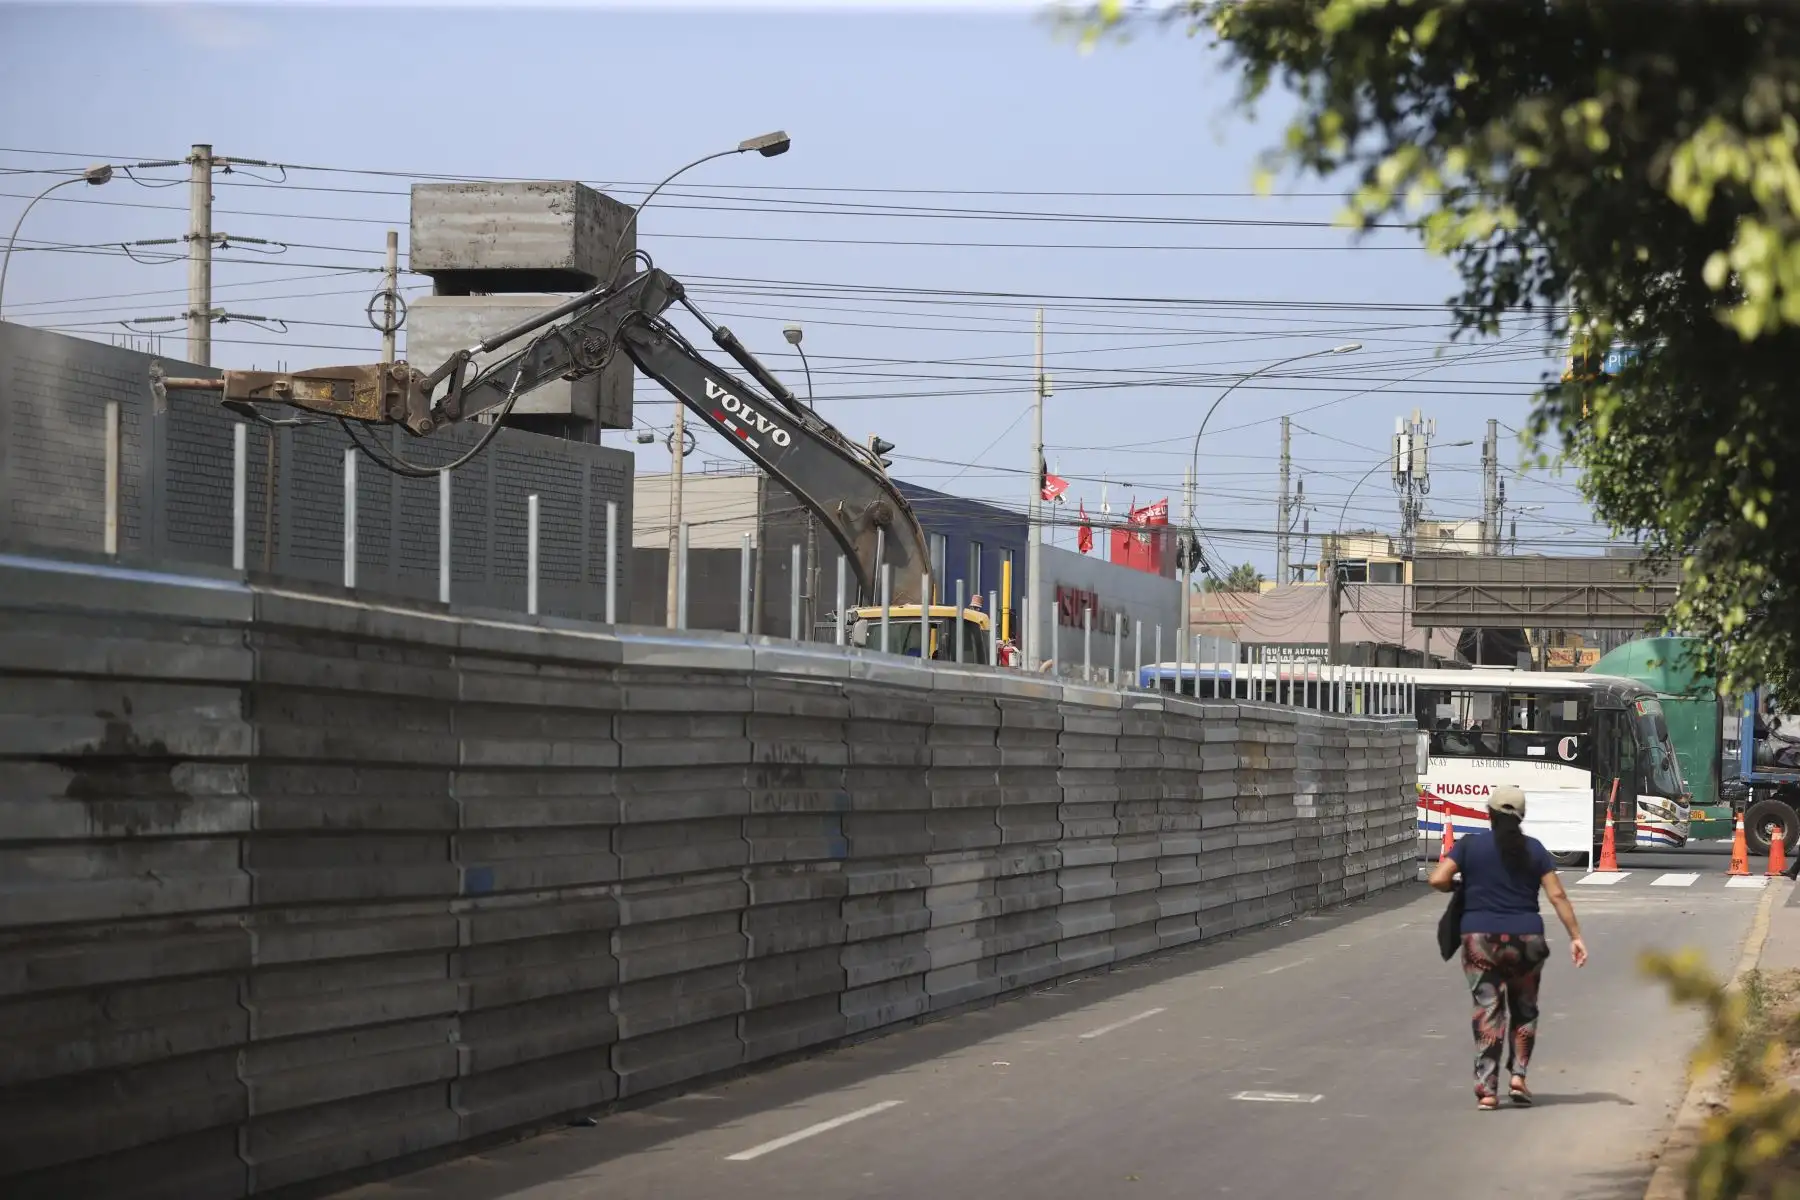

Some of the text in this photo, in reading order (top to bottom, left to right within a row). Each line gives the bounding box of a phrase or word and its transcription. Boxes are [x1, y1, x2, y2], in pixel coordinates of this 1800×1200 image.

[704, 377, 791, 447] VOLVO
[1295, 648, 1329, 656] AUTONIZ
[1557, 736, 1578, 761] C
[1429, 758, 1447, 767] NCAY
[1437, 783, 1492, 796] HUASCA
